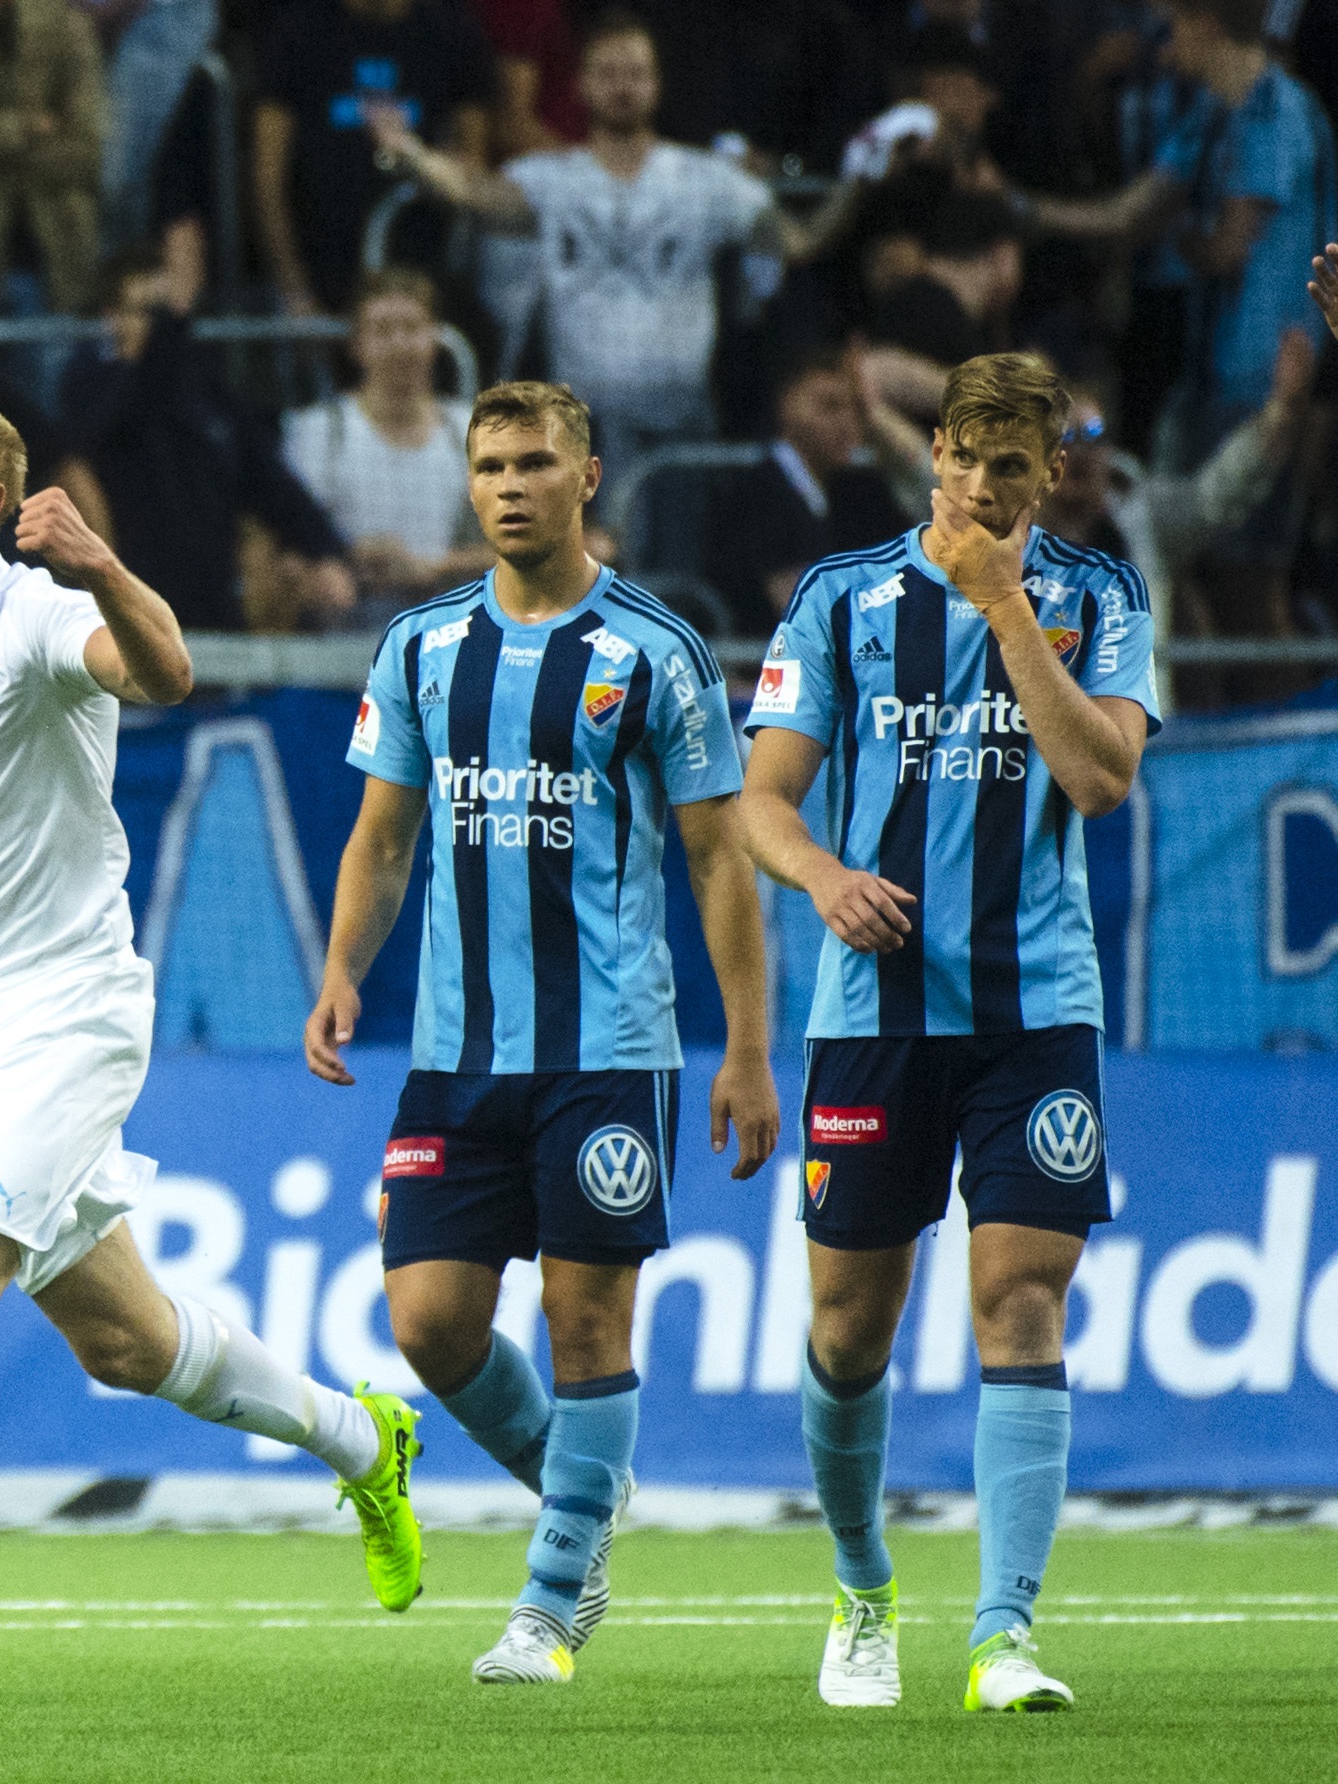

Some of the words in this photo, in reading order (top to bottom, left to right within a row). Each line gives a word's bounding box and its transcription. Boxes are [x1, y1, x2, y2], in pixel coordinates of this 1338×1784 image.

[858, 572, 906, 613] ABT
[423, 615, 473, 654] ABT
[501, 645, 543, 659] Prioritet
[580, 627, 636, 665] ABT
[853, 651, 892, 662] adidas
[663, 654, 709, 771] Stadium
[871, 689, 1031, 740] Priorite
[433, 756, 599, 806] Prioritet
[898, 738, 1027, 785] Finans
[451, 801, 574, 850] Finans
[814, 1113, 879, 1132] Moderna
[384, 1147, 437, 1166] oderna
[543, 1528, 581, 1550] DIF
